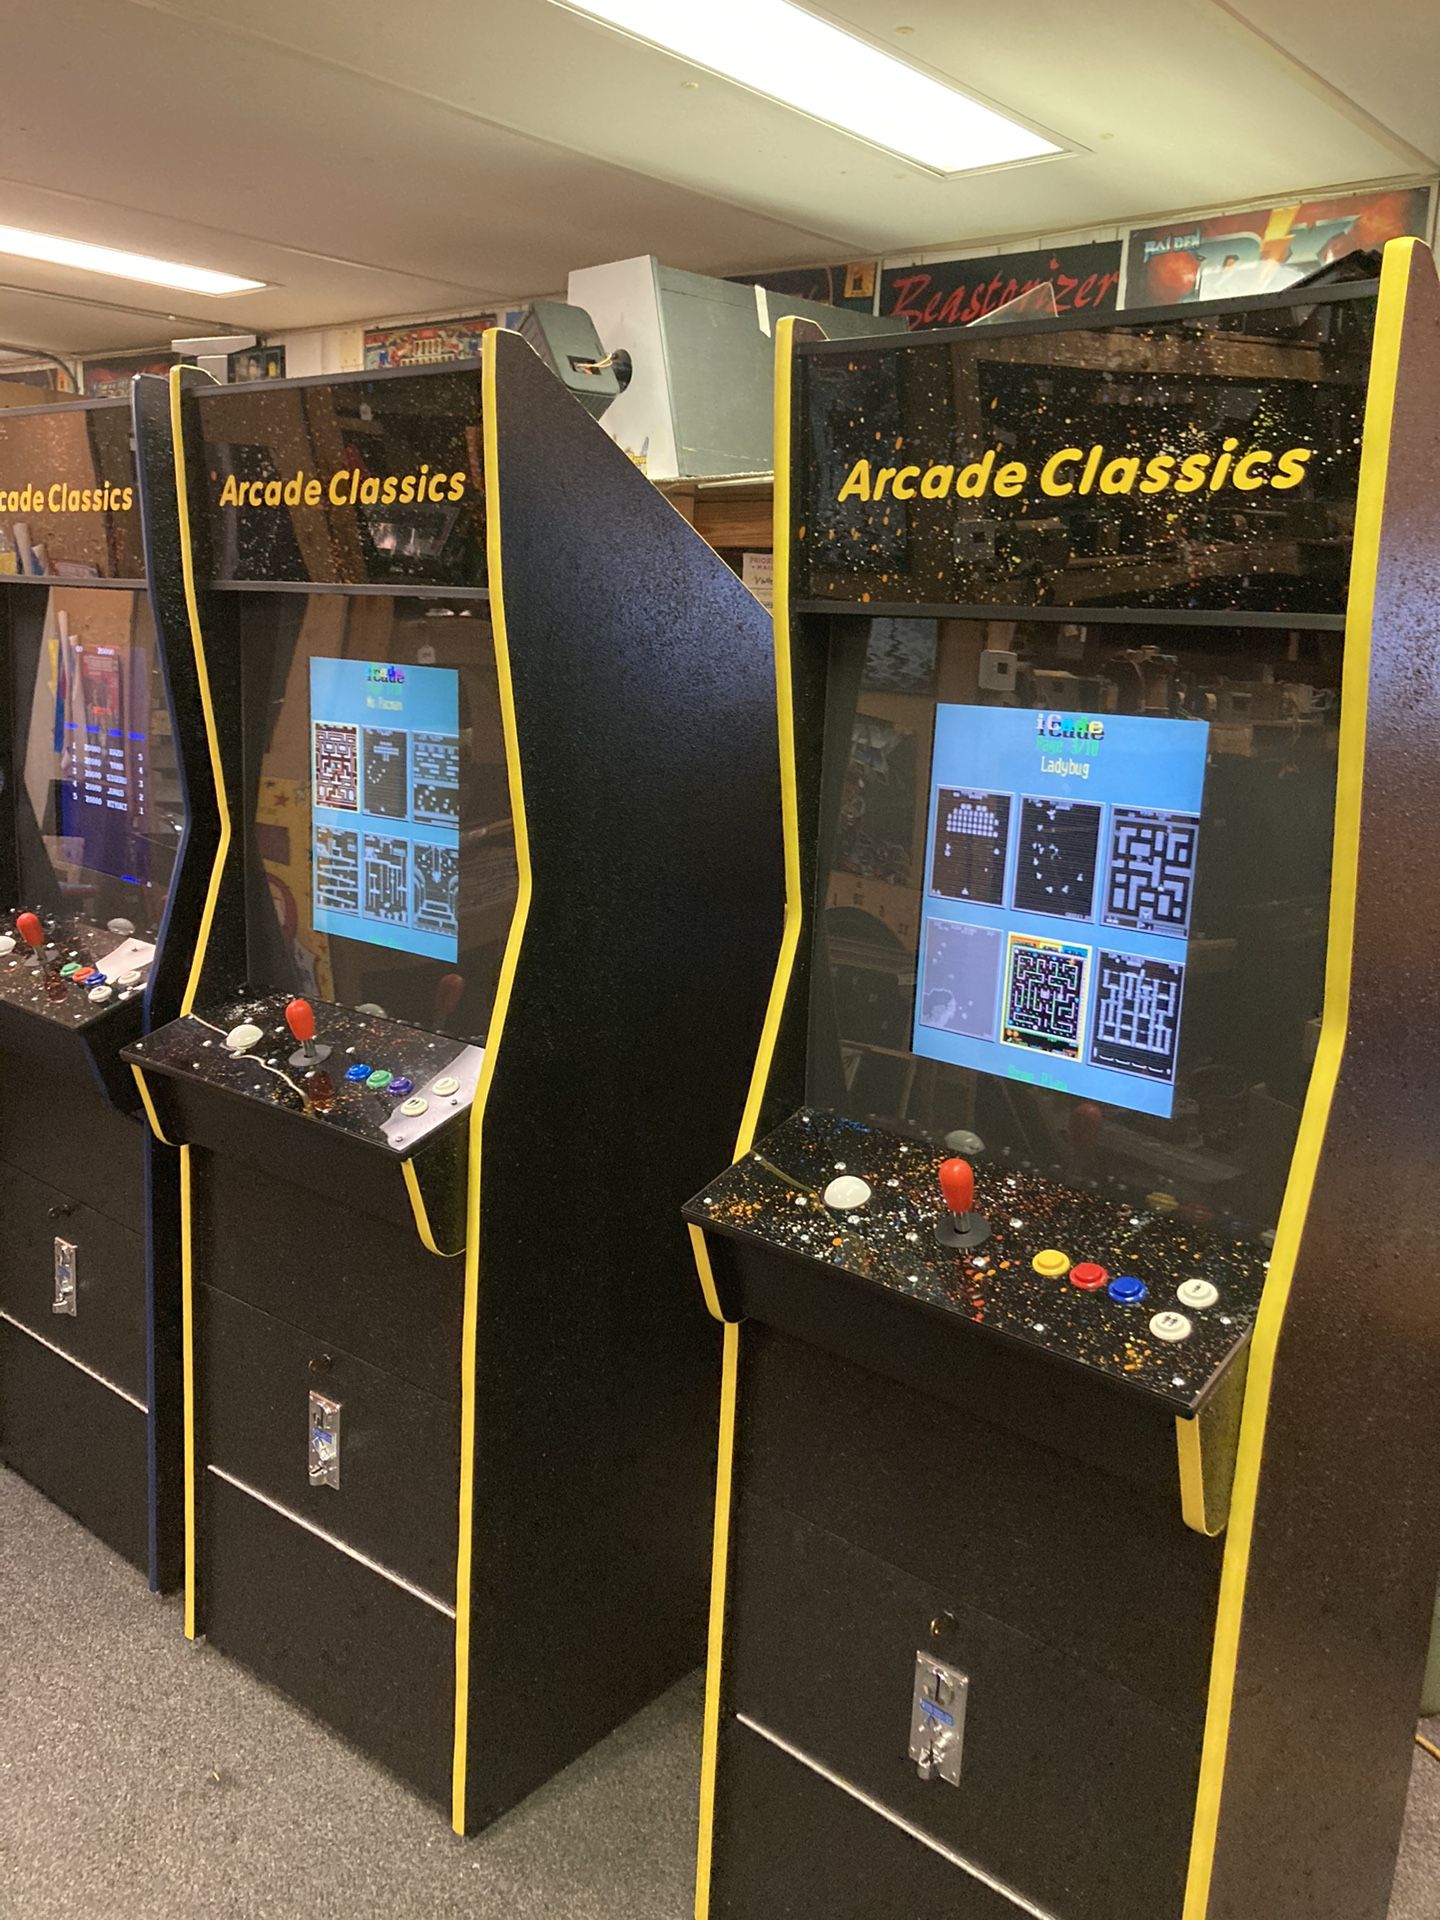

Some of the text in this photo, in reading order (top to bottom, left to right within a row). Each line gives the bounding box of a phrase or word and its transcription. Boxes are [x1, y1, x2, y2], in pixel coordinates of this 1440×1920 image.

[1143, 229, 1201, 263] RAIDEN
[219, 464, 467, 508] Arcade Classics
[838, 437, 1312, 503] Arcade Classics
[47, 481, 133, 513] Classics
[1040, 755, 1090, 780] Ladybug
